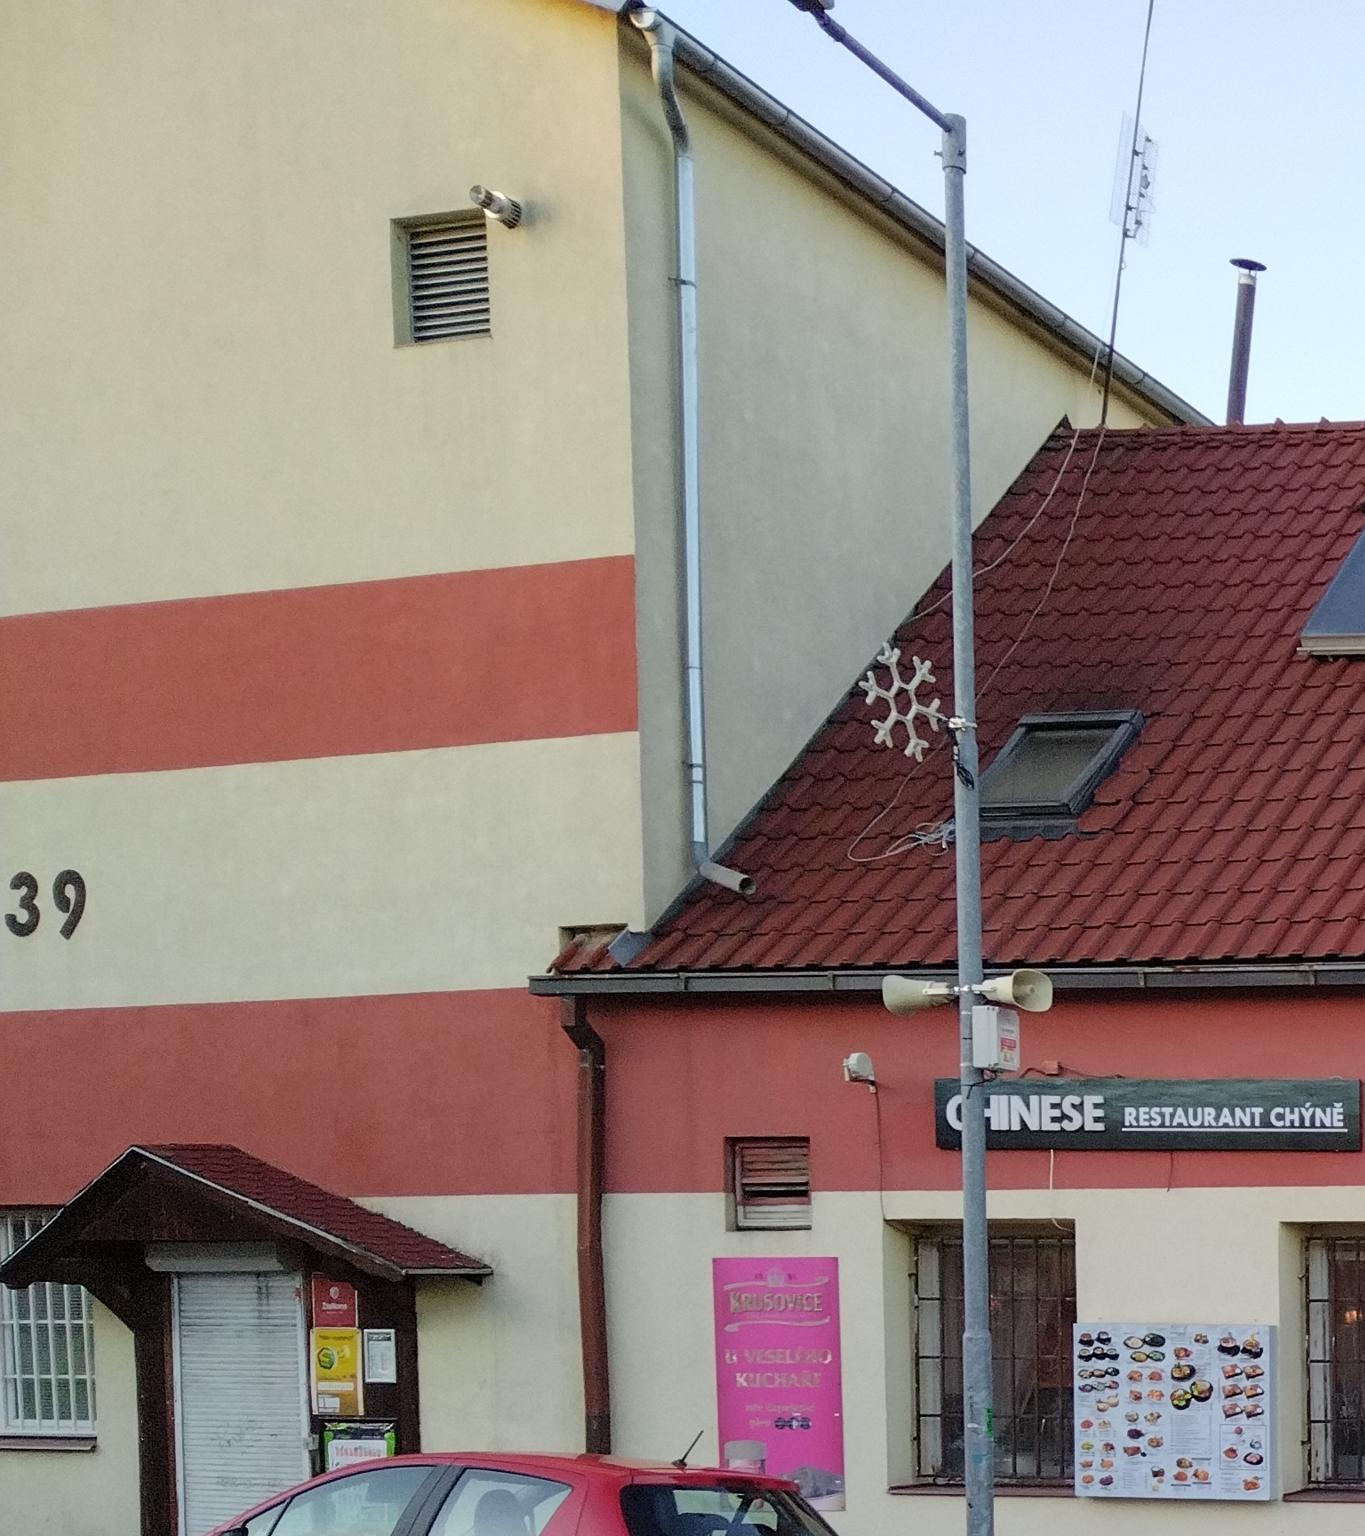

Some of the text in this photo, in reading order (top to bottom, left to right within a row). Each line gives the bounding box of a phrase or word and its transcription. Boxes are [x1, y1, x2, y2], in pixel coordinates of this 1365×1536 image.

[5, 869, 86, 940] 39
[1124, 1106, 1264, 1127] RESTAURANT
[1269, 1102, 1344, 1127] CHÝNĚ
